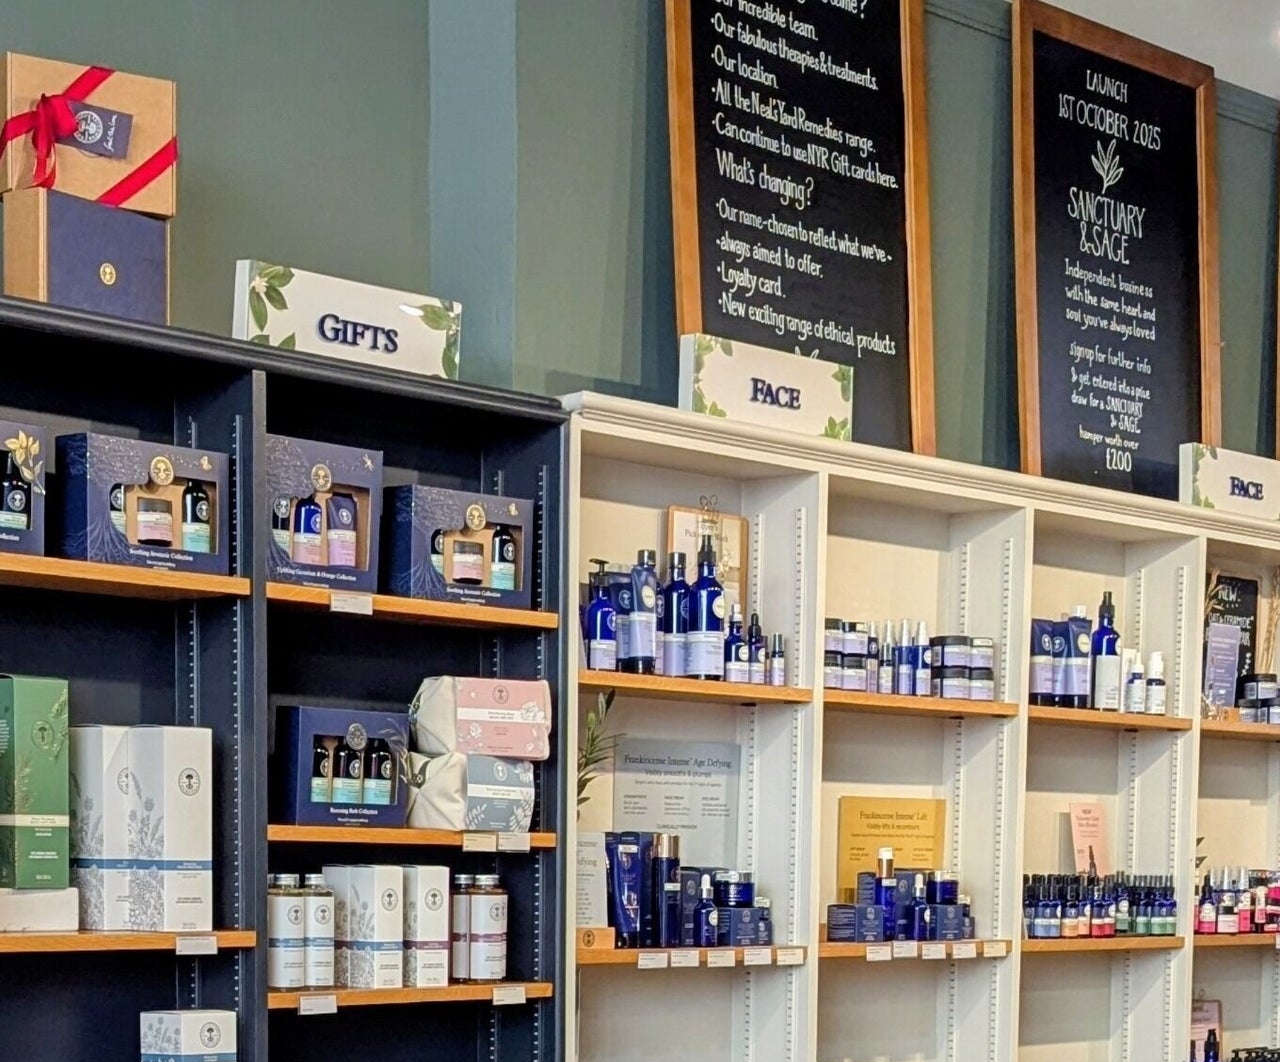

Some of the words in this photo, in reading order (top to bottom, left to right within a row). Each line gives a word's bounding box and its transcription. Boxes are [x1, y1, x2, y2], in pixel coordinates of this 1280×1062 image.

[738, 0, 786, 28] incredible
[788, 11, 818, 41] team.
[715, 12, 734, 38] Our
[737, 21, 778, 56] fabulous
[778, 37, 819, 73] therapies
[827, 55, 879, 91] treatments.
[715, 44, 736, 72] Our
[738, 53, 779, 89] location.
[1086, 69, 1128, 104] LAUNCH
[715, 78, 732, 106] All
[734, 82, 751, 112] the
[751, 90, 778, 122] Neal's
[776, 99, 797, 130] Yard
[798, 105, 843, 144] Remedies
[844, 132, 876, 158] range.
[1058, 93, 1075, 120] 1ST
[1076, 100, 1129, 141] OCTOBER
[1133, 120, 1161, 150] 2025
[715, 112, 739, 140] Can
[738, 125, 780, 154] continue
[780, 134, 791, 156] to
[792, 146, 807, 163] use
[806, 143, 830, 171] NYR
[830, 152, 850, 177] Gift
[851, 161, 876, 183] cards
[875, 162, 899, 189] here.
[715, 148, 755, 186] What's
[759, 163, 814, 211] changing?
[719, 198, 736, 222] Our
[798, 222, 808, 242] to
[809, 228, 837, 250] reflect
[837, 234, 860, 255] what
[1068, 186, 1145, 239] SANCTUARY
[719, 231, 751, 263] always
[752, 243, 782, 267] aimed
[784, 248, 795, 269] to
[797, 254, 824, 278] offer.
[1092, 225, 1130, 265] SAGE
[721, 261, 757, 297] Loyalty
[758, 275, 786, 299] card.
[1065, 258, 1116, 289] Independent
[1119, 274, 1153, 298] business
[1065, 284, 1084, 302] with
[1084, 287, 1098, 306] the
[1100, 296, 1121, 312] same
[1121, 296, 1142, 318] heart
[1142, 308, 1156, 321] and
[318, 313, 399, 353] GIFTS
[722, 291, 745, 318] New
[748, 304, 785, 335] exciting
[786, 315, 813, 341] range
[814, 319, 825, 338] of
[824, 322, 854, 347] ethical
[856, 333, 896, 358] products
[1065, 308, 1081, 322] soul
[1081, 313, 1109, 330] you've
[1109, 315, 1133, 341] always
[1132, 320, 1156, 341] loved
[1070, 341, 1086, 363] sign
[1085, 348, 1095, 367] up
[1095, 345, 1106, 363] for
[1107, 347, 1135, 370] further
[1136, 357, 1152, 375] info
[750, 378, 802, 410] FACE
[1092, 374, 1117, 392] entered
[1079, 424, 1104, 446] hamper
[1118, 414, 1141, 433] SAGE
[1106, 447, 1132, 472] £200
[1229, 476, 1264, 500] FACE
